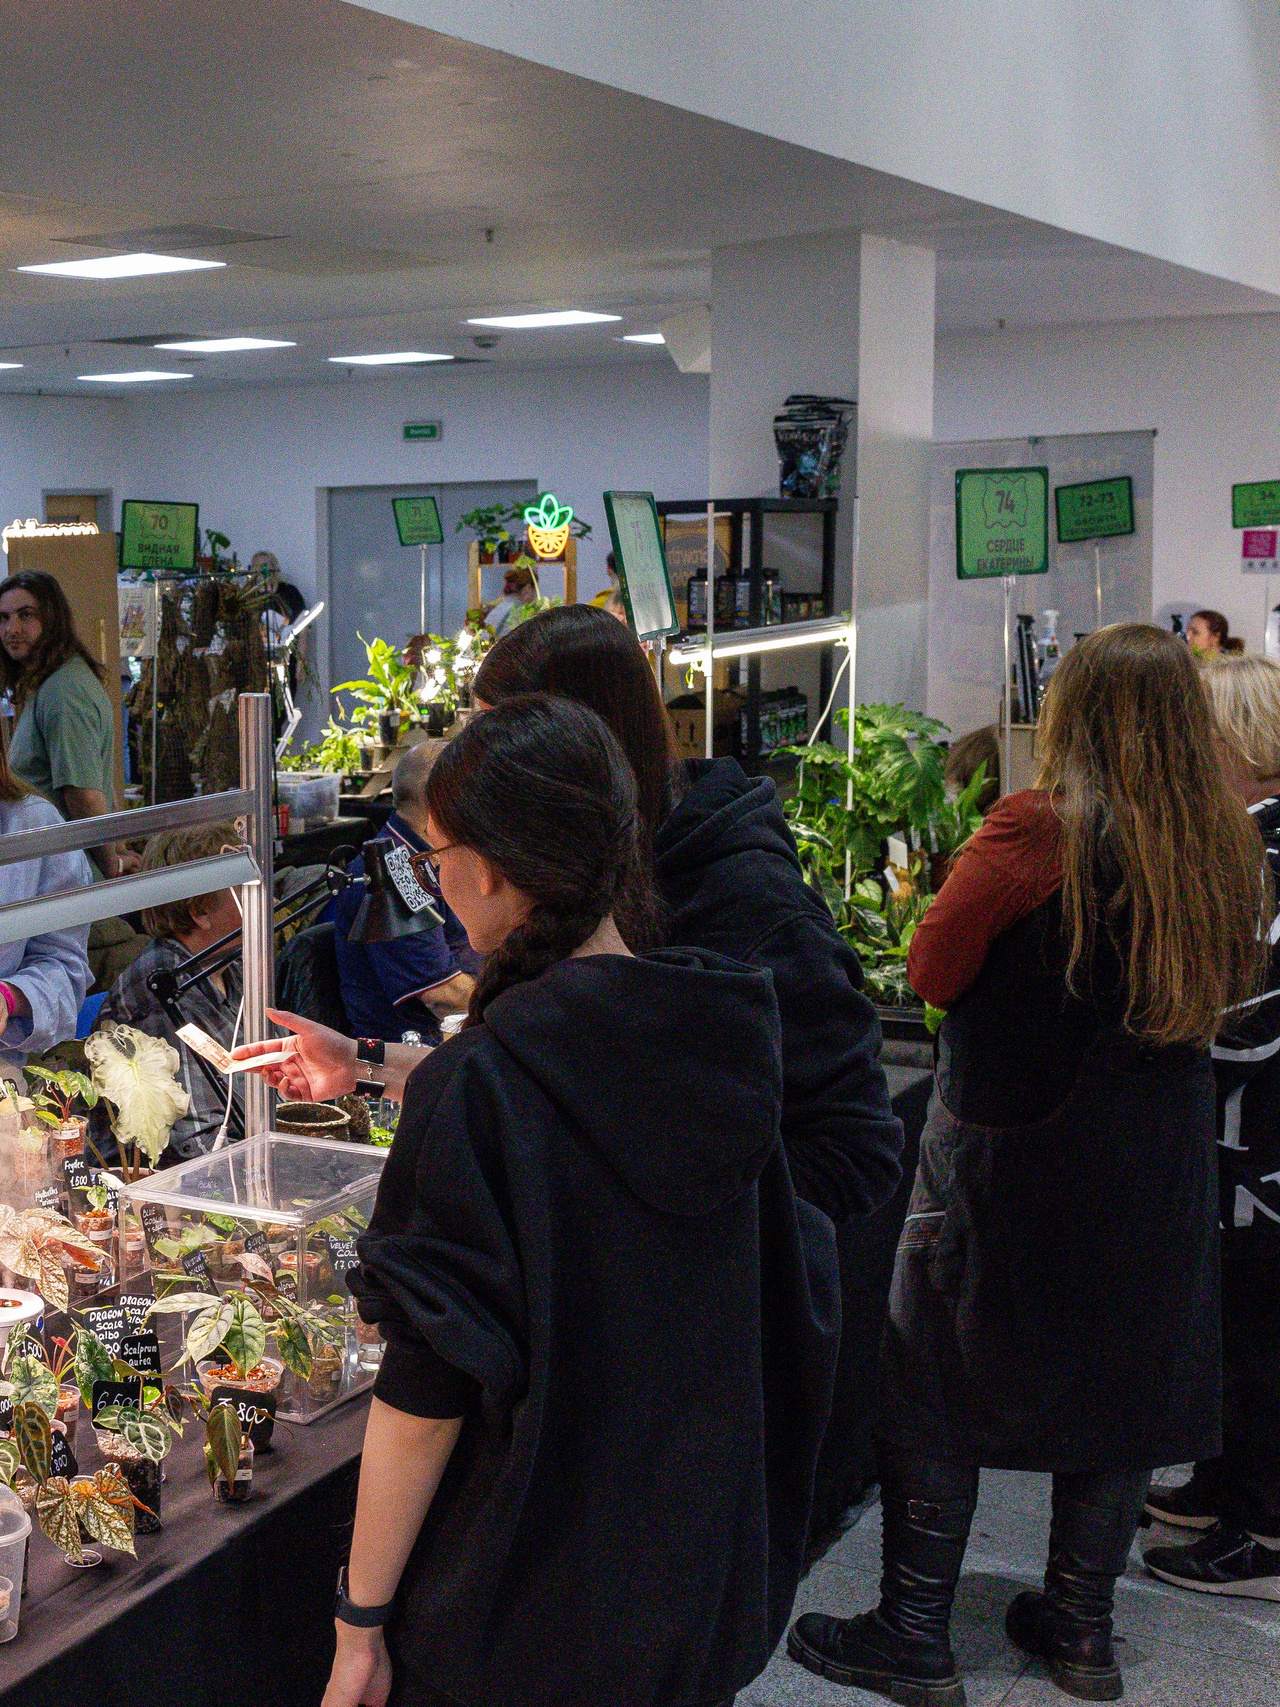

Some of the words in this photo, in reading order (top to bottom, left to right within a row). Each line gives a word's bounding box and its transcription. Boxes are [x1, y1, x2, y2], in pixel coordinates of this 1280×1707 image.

[995, 490, 1016, 514] 74
[151, 514, 169, 531] 70
[987, 537, 1025, 554] СЕРДЦЕ
[330, 1241, 354, 1250] VELVET
[120, 1295, 156, 1307] DRAGON
[89, 1308, 124, 1322] DRAGON
[98, 1330, 120, 1341] albo
[123, 1341, 158, 1359] Scalprum
[128, 1357, 152, 1367] aurea
